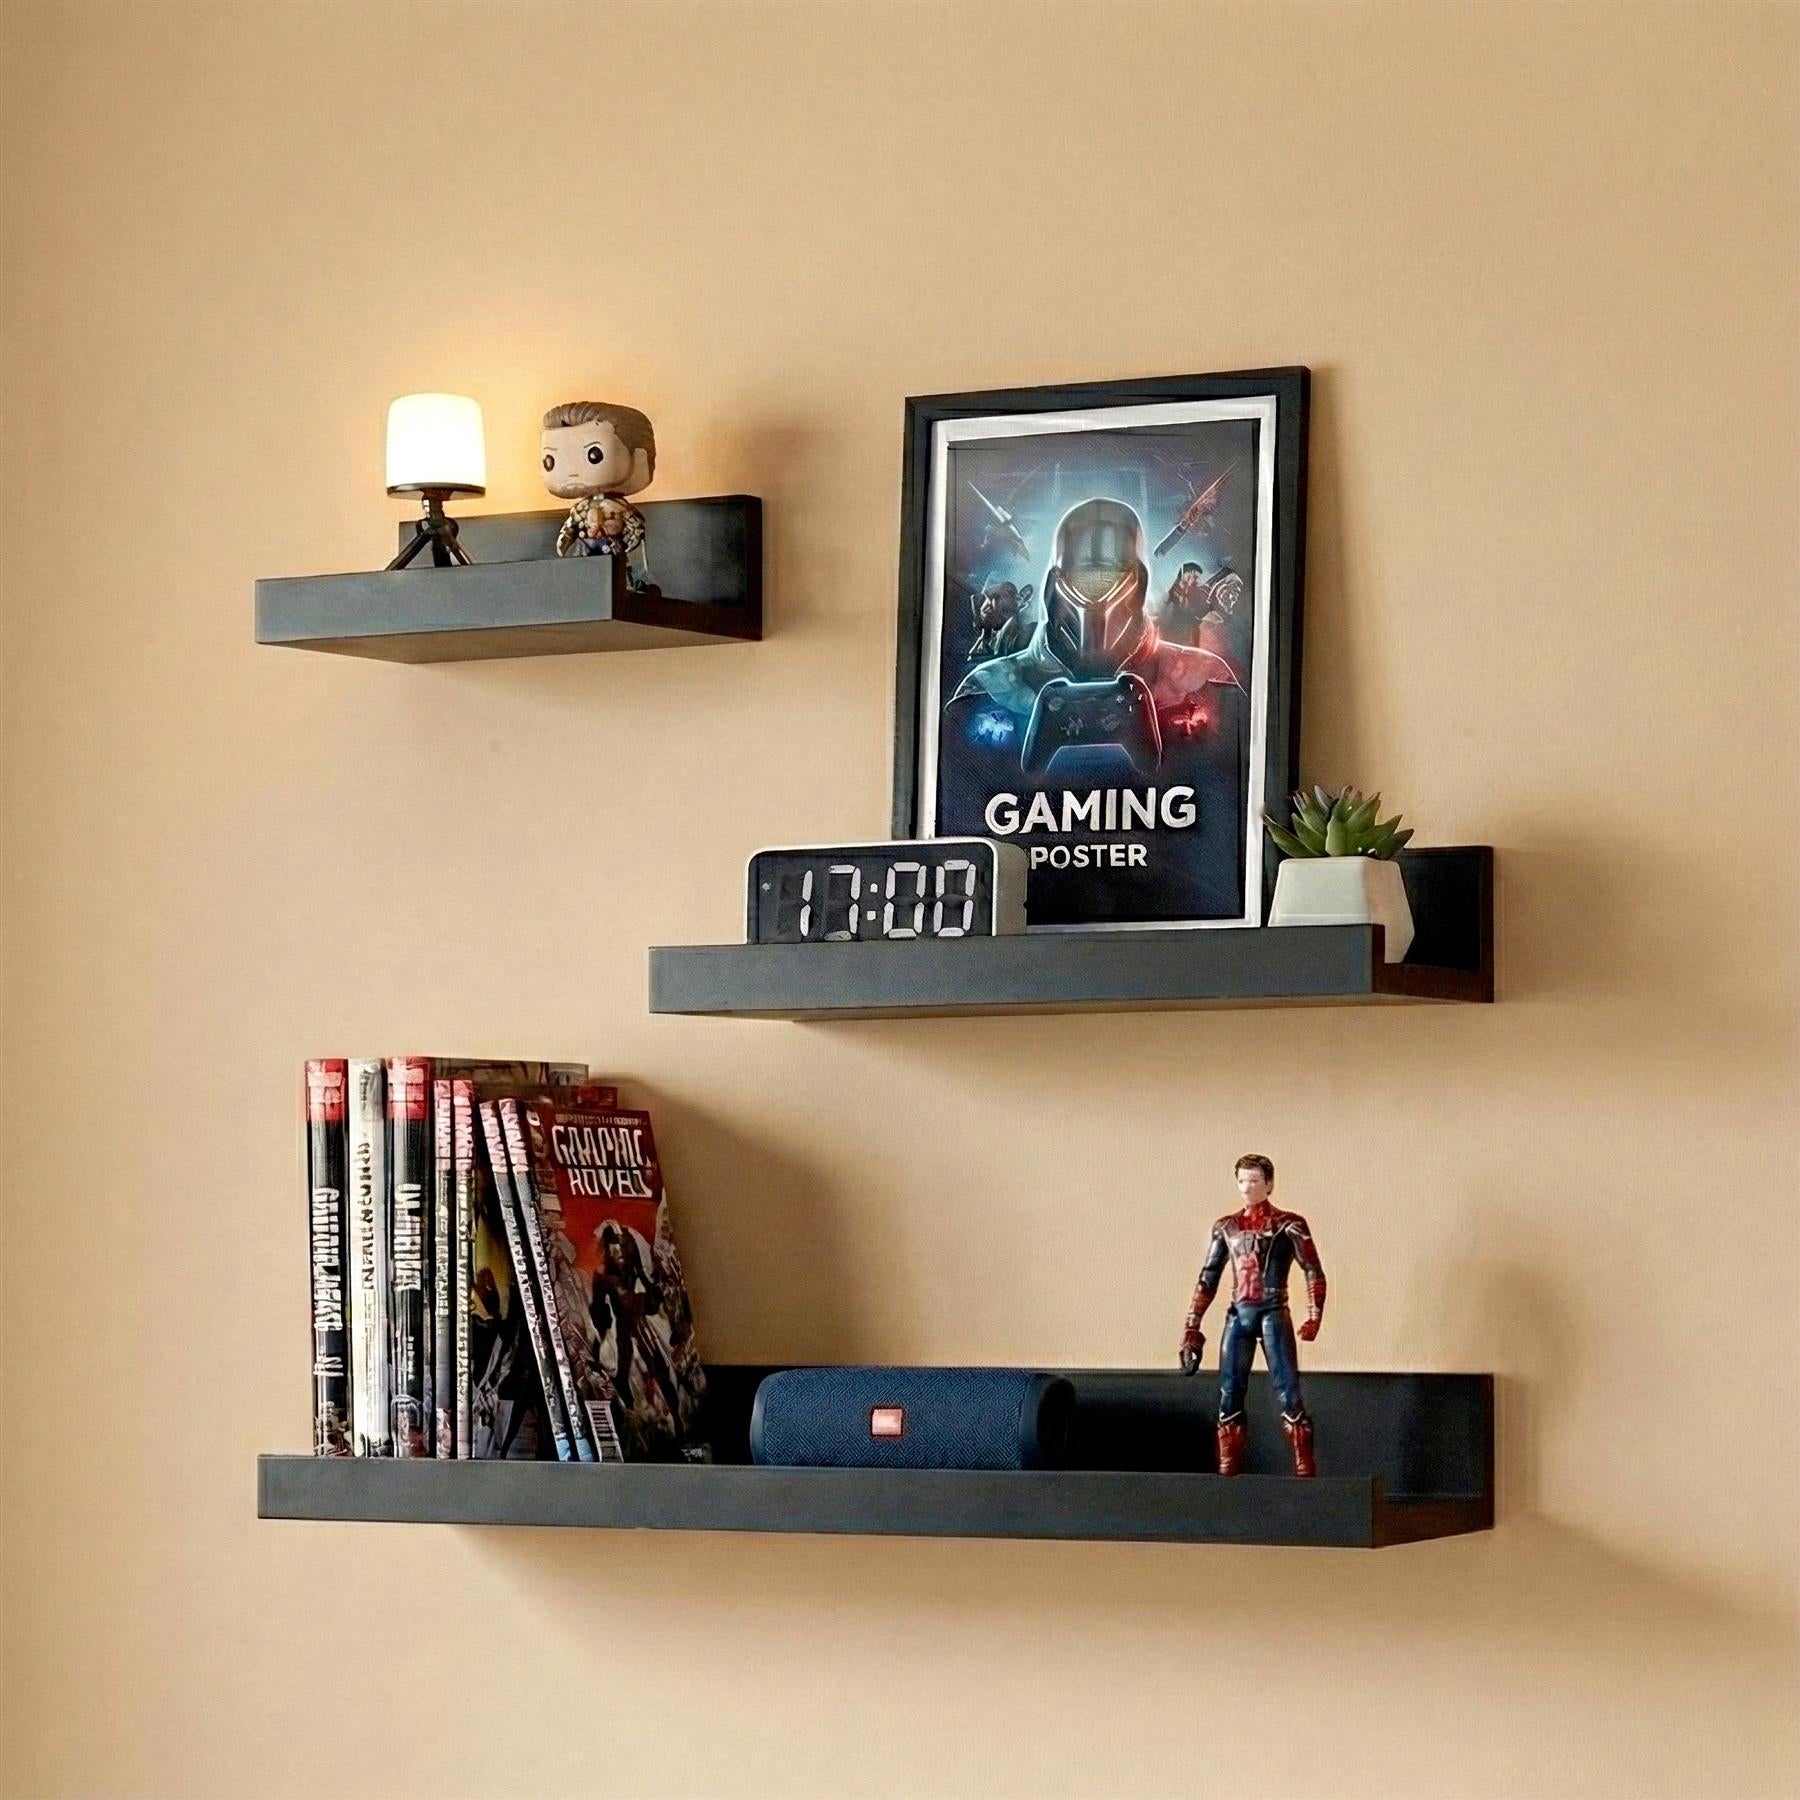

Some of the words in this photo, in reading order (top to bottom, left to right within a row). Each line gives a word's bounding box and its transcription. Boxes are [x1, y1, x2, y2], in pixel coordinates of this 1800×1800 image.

[985, 786, 1196, 835] GAMING
[1030, 844, 1148, 870] POSTER
[800, 859, 977, 941] 17:00
